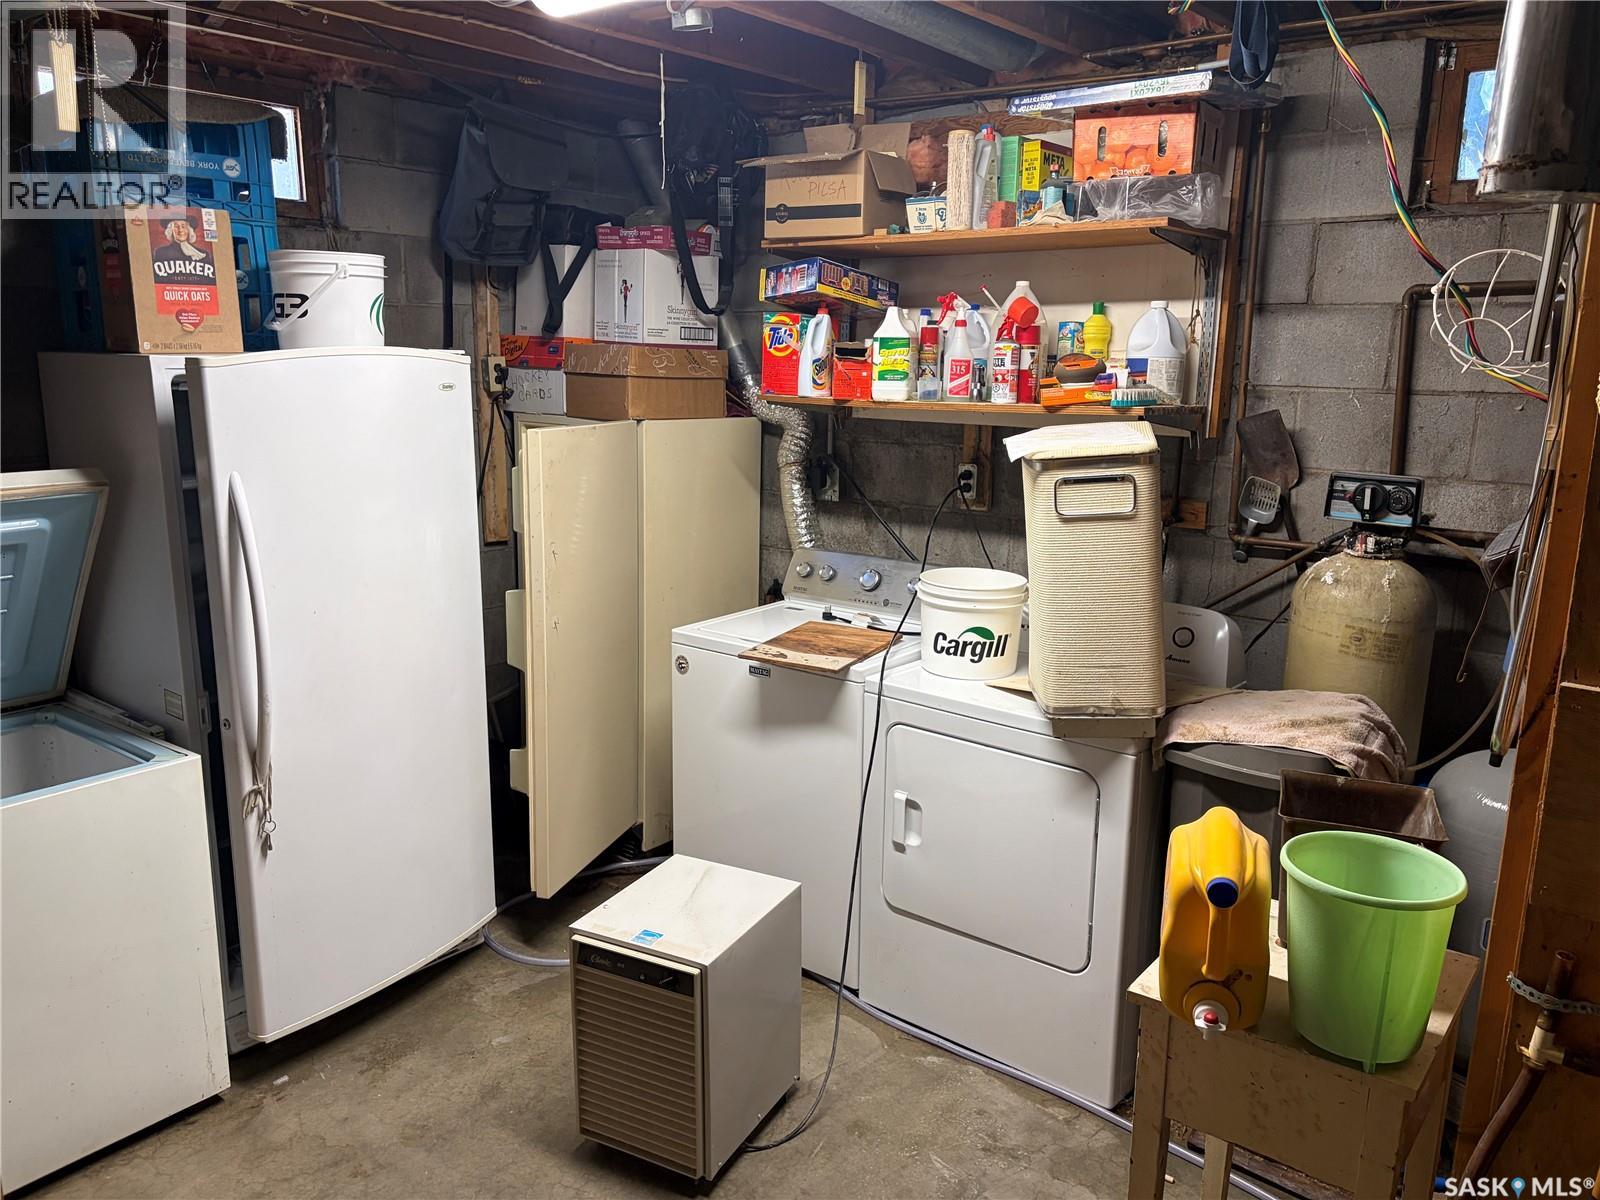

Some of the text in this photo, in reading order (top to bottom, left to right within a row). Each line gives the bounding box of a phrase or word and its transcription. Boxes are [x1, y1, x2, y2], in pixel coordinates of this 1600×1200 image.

[198, 161, 220, 170] YORK
[1043, 151, 1065, 170] META
[154, 260, 215, 278] QUAKER
[164, 290, 211, 302] QUICK OATS
[880, 349, 910, 358] Spray
[951, 365, 966, 375] 315
[511, 369, 549, 390] HOCKEY
[519, 388, 552, 401] CARDS
[933, 632, 1009, 664] Cargill
